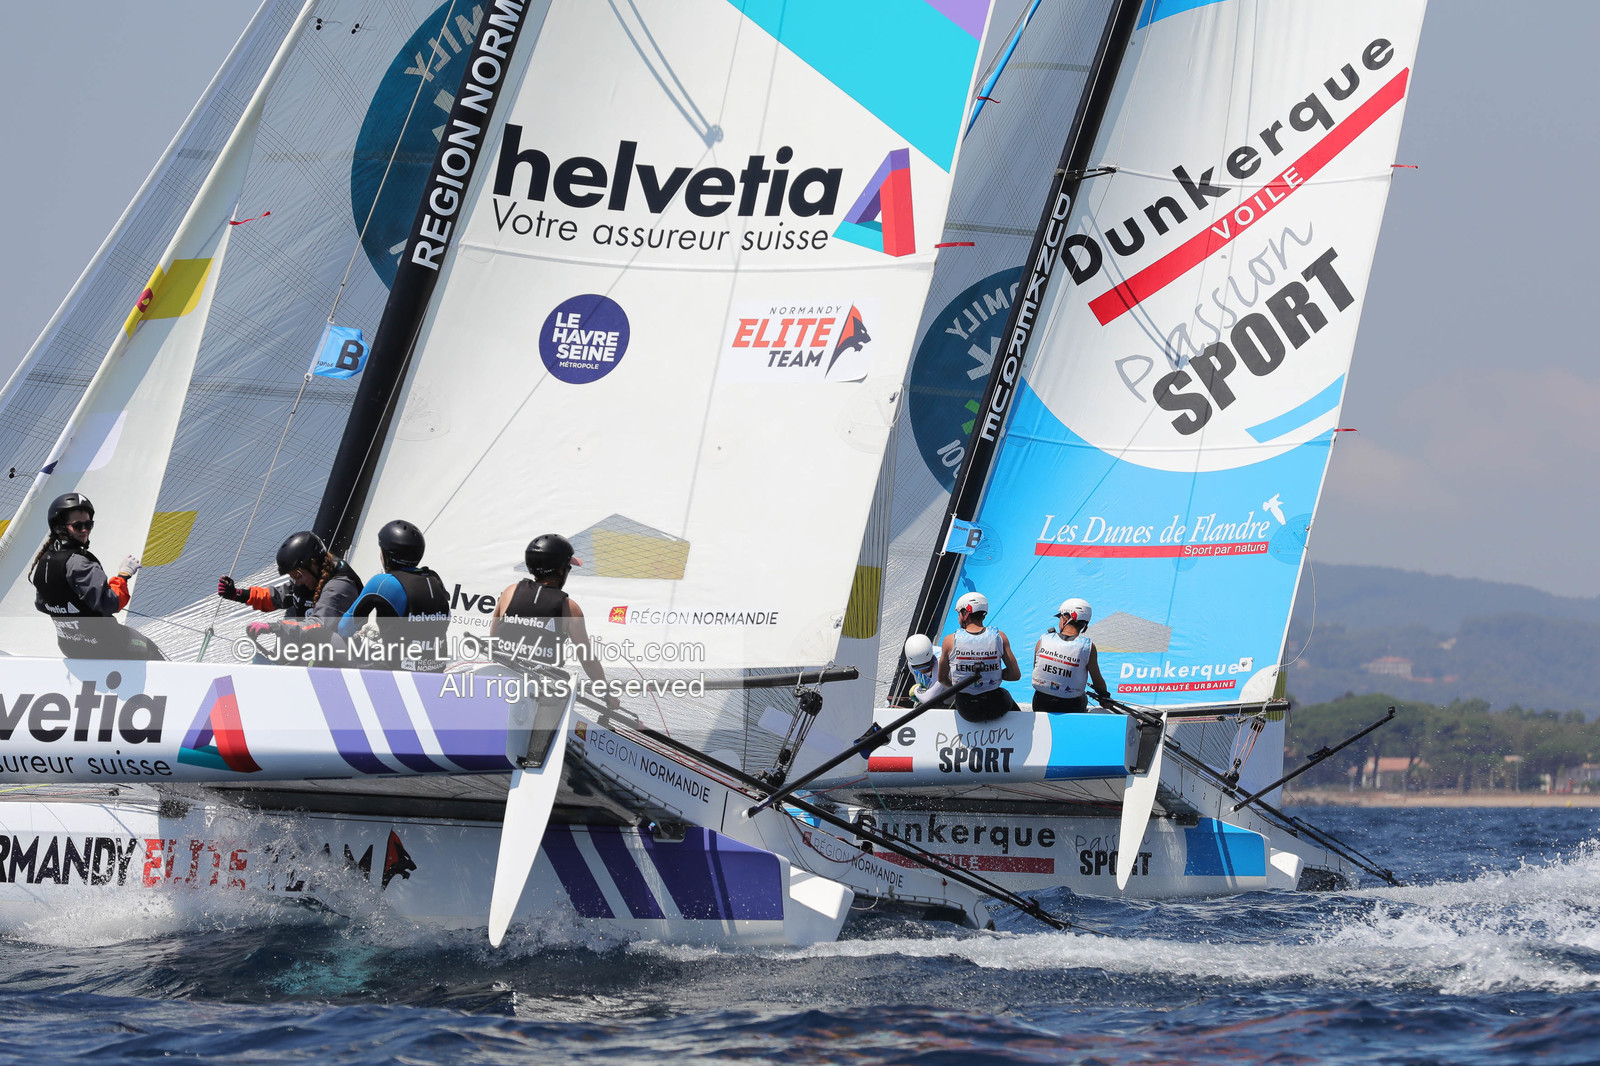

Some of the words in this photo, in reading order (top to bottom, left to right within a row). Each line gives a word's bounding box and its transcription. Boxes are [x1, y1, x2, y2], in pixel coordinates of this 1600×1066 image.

[492, 122, 844, 218] helvetia
[1060, 37, 1395, 286] Dunkerque
[411, 118, 481, 271] REGION
[1211, 166, 1304, 241] VOILE
[493, 197, 578, 241] Votre
[592, 222, 730, 252] assureur
[740, 221, 829, 252] suisse
[555, 312, 581, 328] LE
[769, 305, 842, 315] NORMANDY
[981, 192, 1071, 442] DUNKERQUE
[552, 328, 620, 347] HAVRE
[732, 318, 836, 348] ELITE
[1152, 246, 1355, 436] SPORT
[335, 339, 364, 371] B
[556, 344, 616, 362] SEINE
[768, 350, 824, 367] TEAM
[559, 360, 600, 370] MÉTROPOLE
[966, 528, 982, 549] B
[1037, 514, 1078, 543] Les
[1080, 516, 1153, 544] Dunes
[1160, 514, 1186, 544] de
[1189, 510, 1270, 543] Flandre
[1184, 544, 1212, 556] Sport
[1214, 546, 1231, 556] par
[1234, 542, 1267, 553] nature
[408, 611, 447, 622] helvetia
[504, 613, 544, 629] helvetia
[630, 608, 690, 625] RÉGION
[692, 611, 779, 625] NORMANDIE
[1043, 664, 1072, 678] JESTIN
[1120, 660, 1239, 681] Dunkerque
[1118, 683, 1190, 692] COMMUNAUTÉ
[1194, 680, 1235, 690] URBAINE
[87, 750, 173, 776] suisse
[590, 730, 638, 767] RÉGION
[640, 756, 710, 803] NORMANDIE
[938, 747, 1014, 773] SPORT
[852, 855, 904, 888] NORMANDIE
